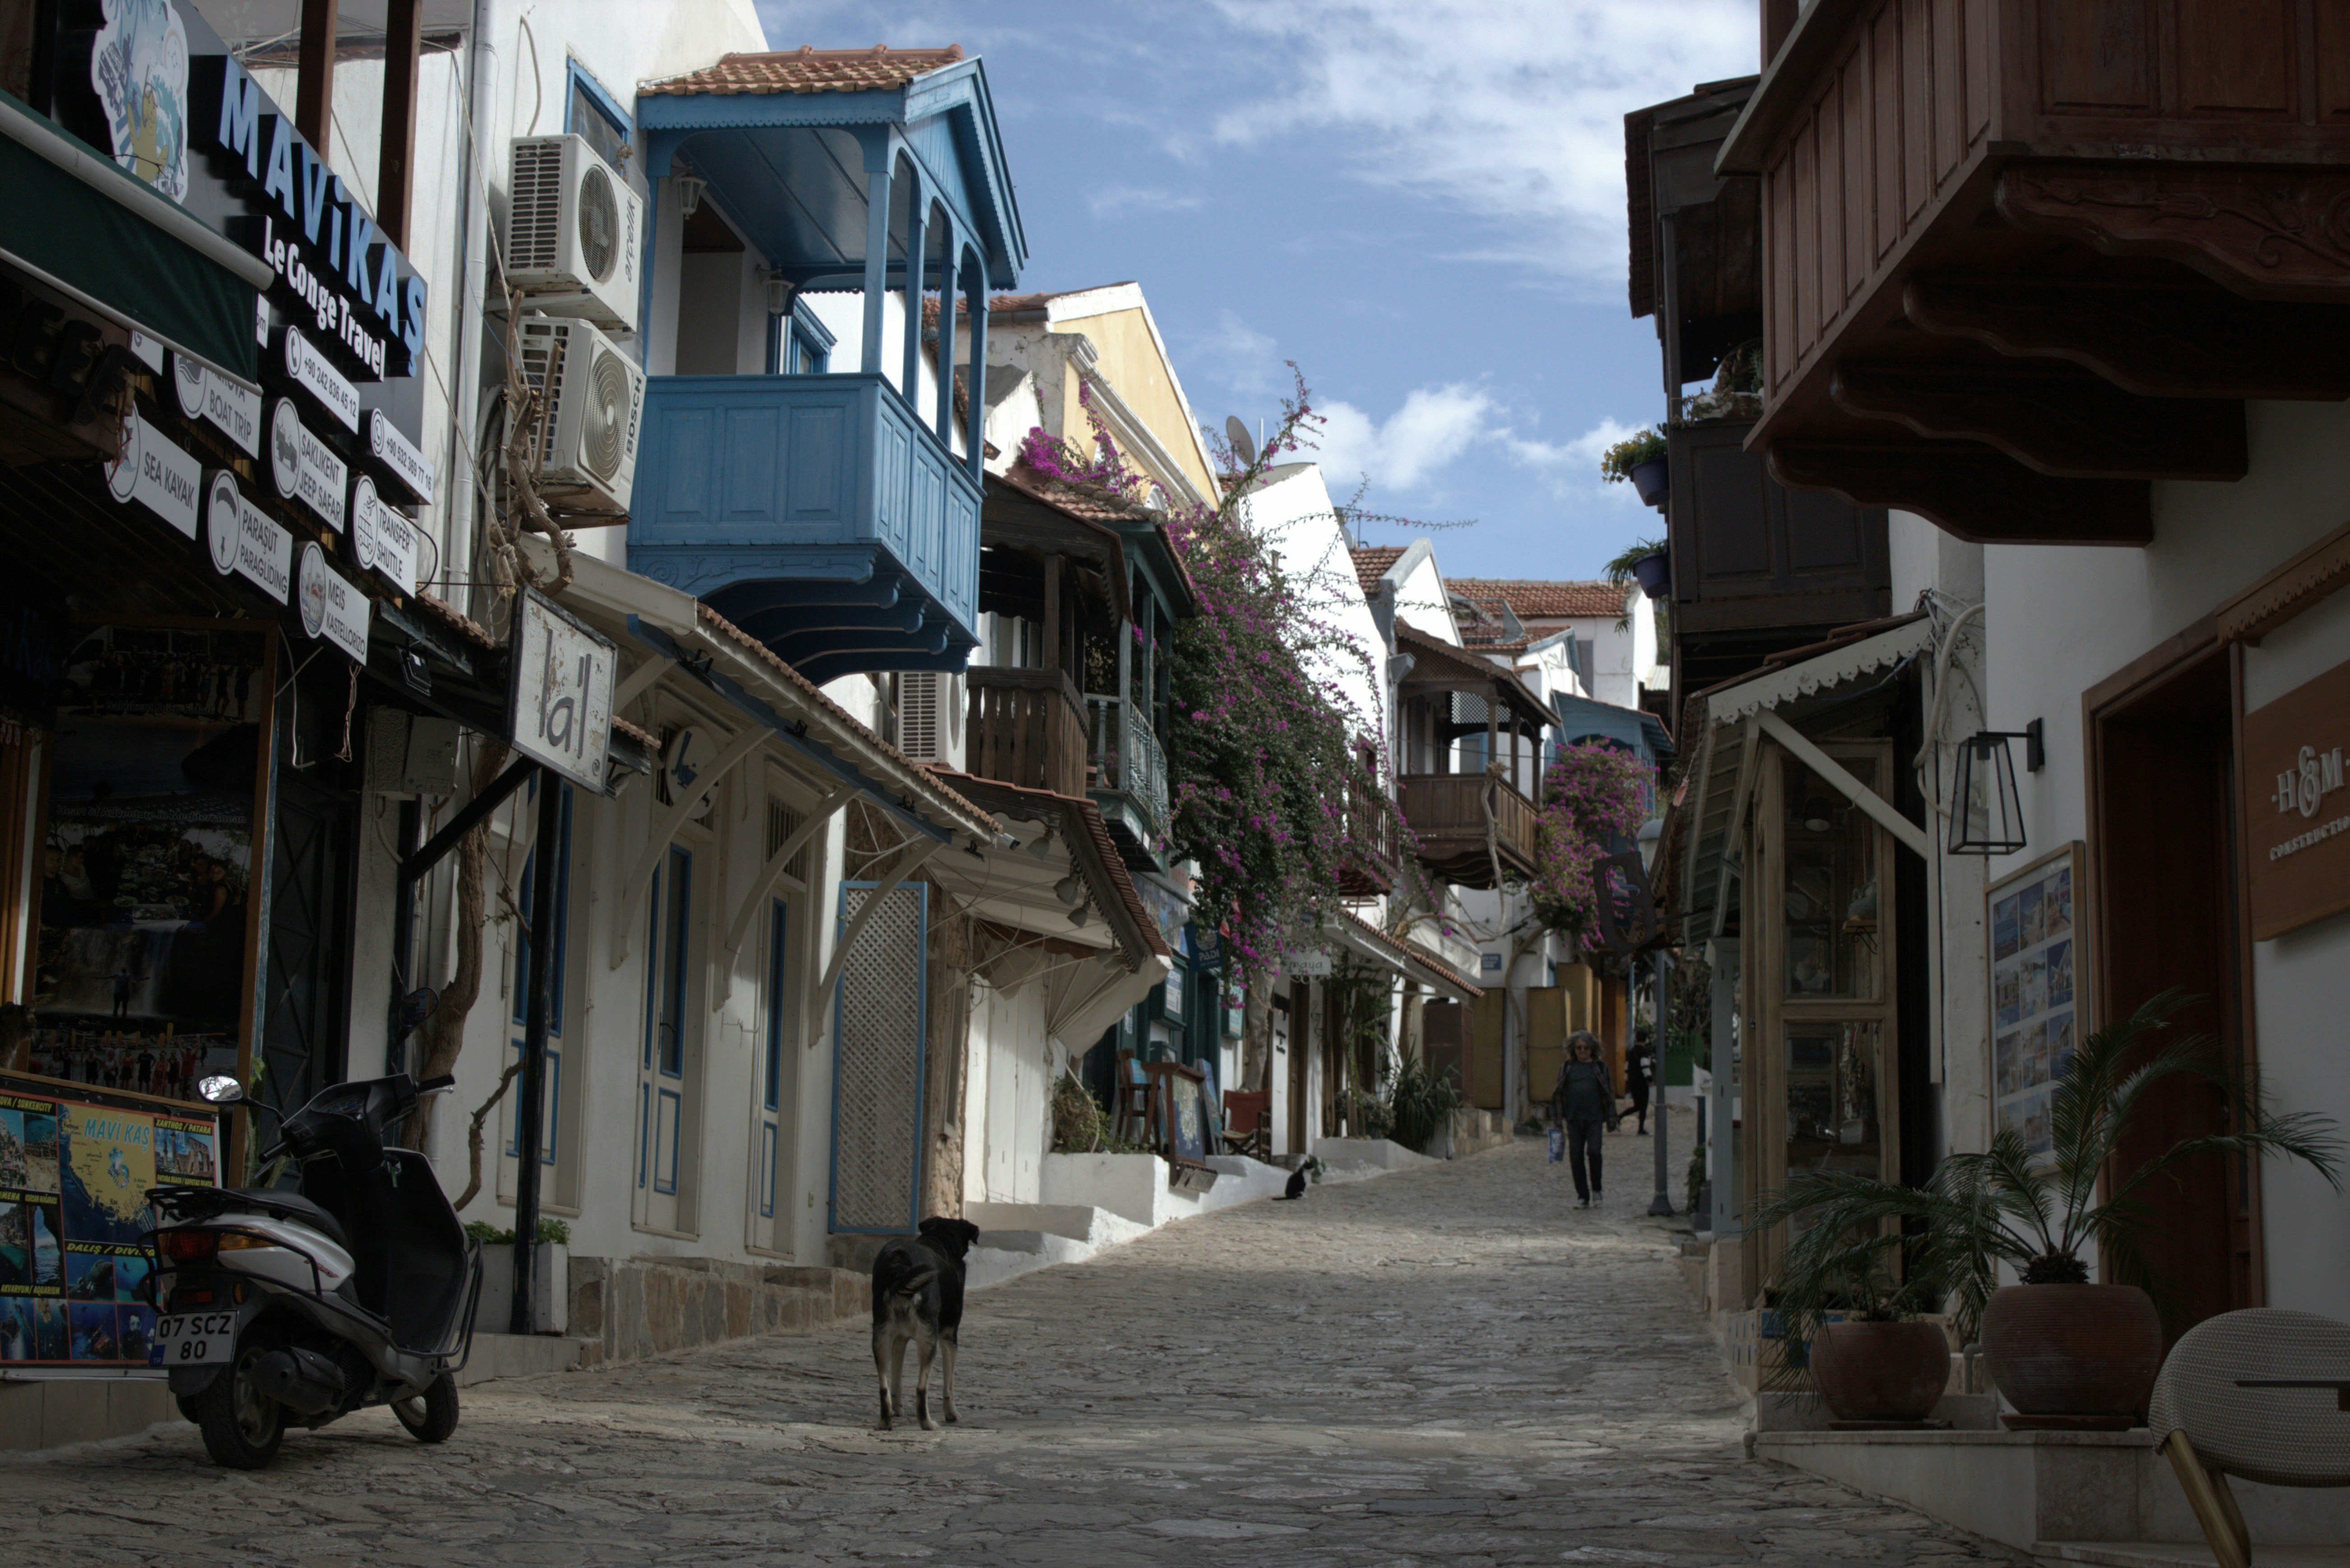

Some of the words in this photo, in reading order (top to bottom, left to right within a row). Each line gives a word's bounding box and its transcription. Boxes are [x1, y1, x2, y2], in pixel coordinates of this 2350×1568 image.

[625, 196, 635, 282] arçelik
[264, 215, 285, 275] Le
[287, 243, 337, 330] Conge
[339, 294, 386, 382] Travel
[304, 357, 315, 378] +90
[317, 367, 328, 391] 242
[329, 379, 339, 402] 836
[341, 391, 348, 412] 45
[349, 398, 356, 418] 12
[210, 389, 232, 428] BOAT
[626, 376, 642, 454] BOSCH
[301, 434, 339, 486] SAKLIKENT
[387, 437, 396, 457] +90
[398, 447, 407, 470] 532
[408, 457, 417, 478] 369
[418, 466, 424, 482] 77
[426, 474, 431, 491] 16
[144, 451, 162, 487] SEA
[165, 466, 194, 510] KAYAK
[299, 470, 316, 500] JEEP
[242, 508, 278, 555] PARAŞÜT
[379, 507, 410, 554] TRANSFER
[377, 541, 402, 580] SHUTTLE
[328, 578, 345, 610] MEİS
[1199, 949, 1220, 961] PADI
[84, 1115, 123, 1142] MAVİ
[124, 1123, 150, 1152] KAŞ
[156, 1119, 182, 1130] XANTHOS
[188, 1124, 212, 1134] PATARA
[66, 1243, 102, 1254] DALIŞ
[114, 1246, 156, 1257] DIVG
[160, 1318, 185, 1338] 07
[191, 1315, 231, 1335] SCZ
[180, 1340, 207, 1360] 80
